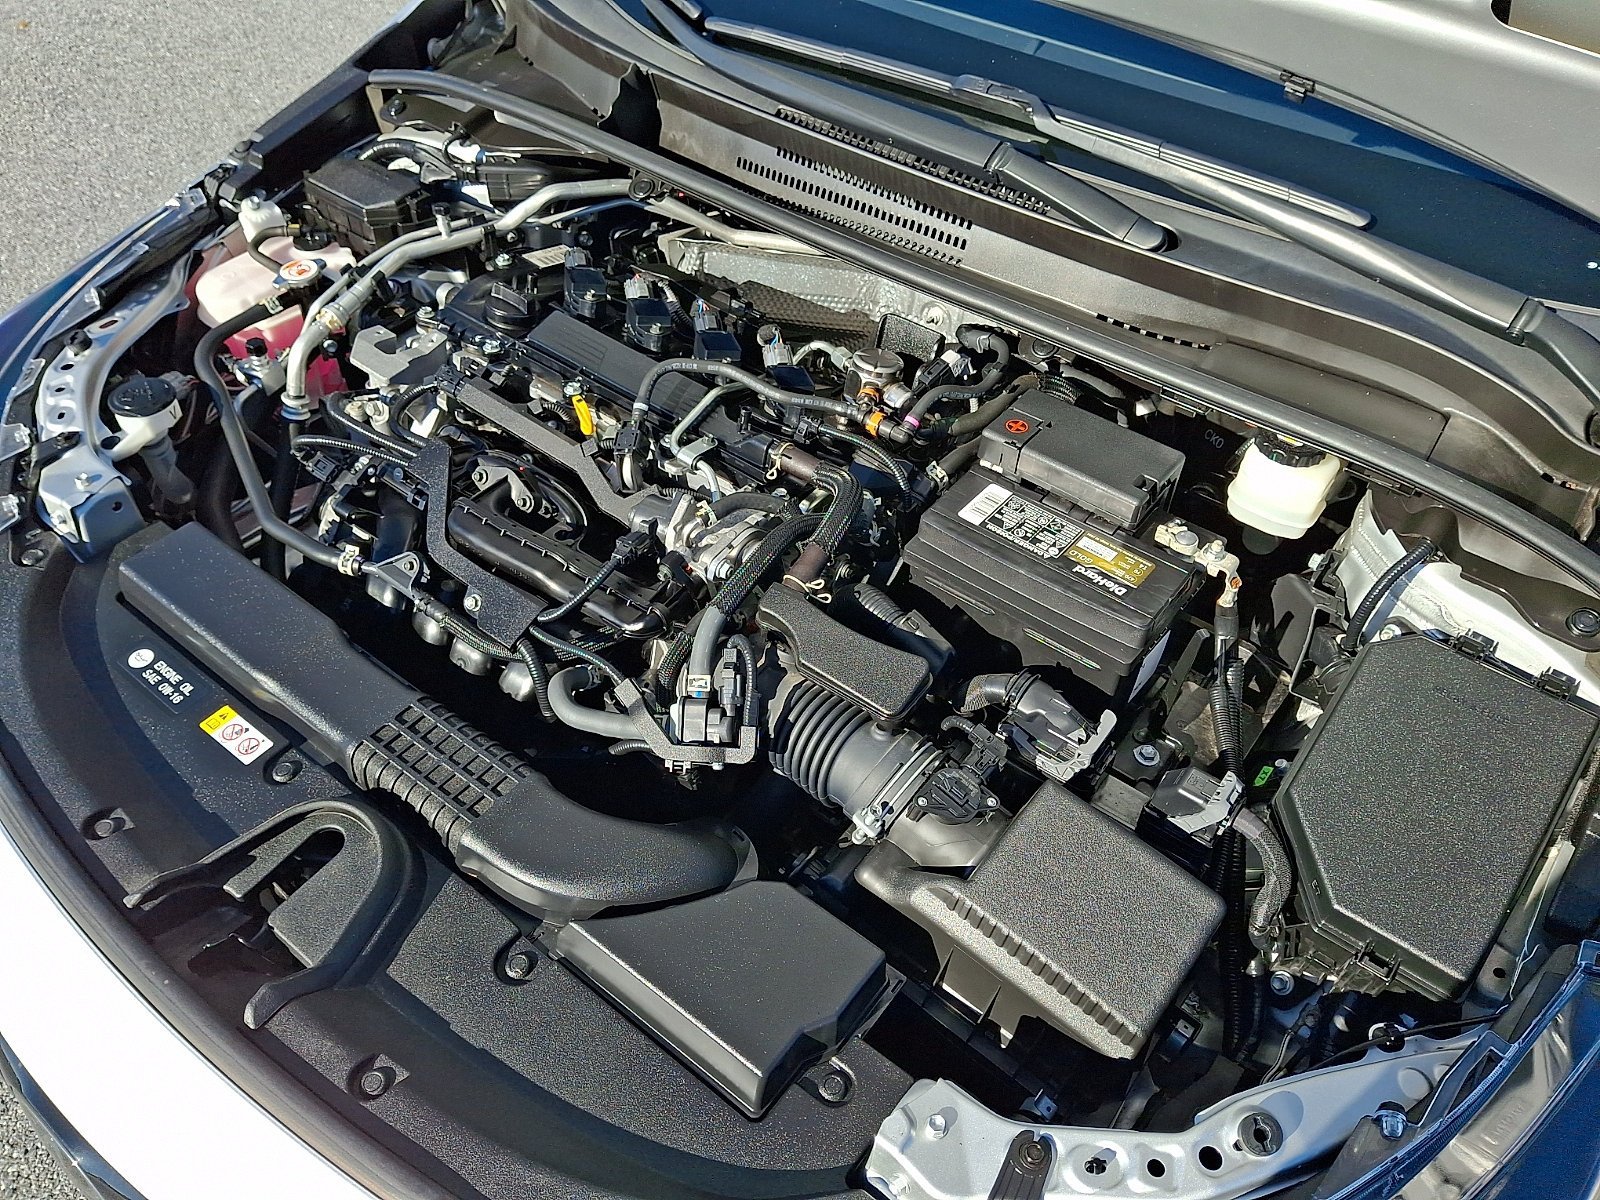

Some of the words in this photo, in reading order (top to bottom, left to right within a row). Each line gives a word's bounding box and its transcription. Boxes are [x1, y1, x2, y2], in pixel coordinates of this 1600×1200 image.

[1069, 549, 1093, 564] GOLD
[1072, 565, 1128, 596] DieHard
[142, 669, 162, 685] SAE
[157, 684, 184, 704] 0W-16
[153, 660, 183, 685] ENGINE
[180, 682, 195, 696] OIL
